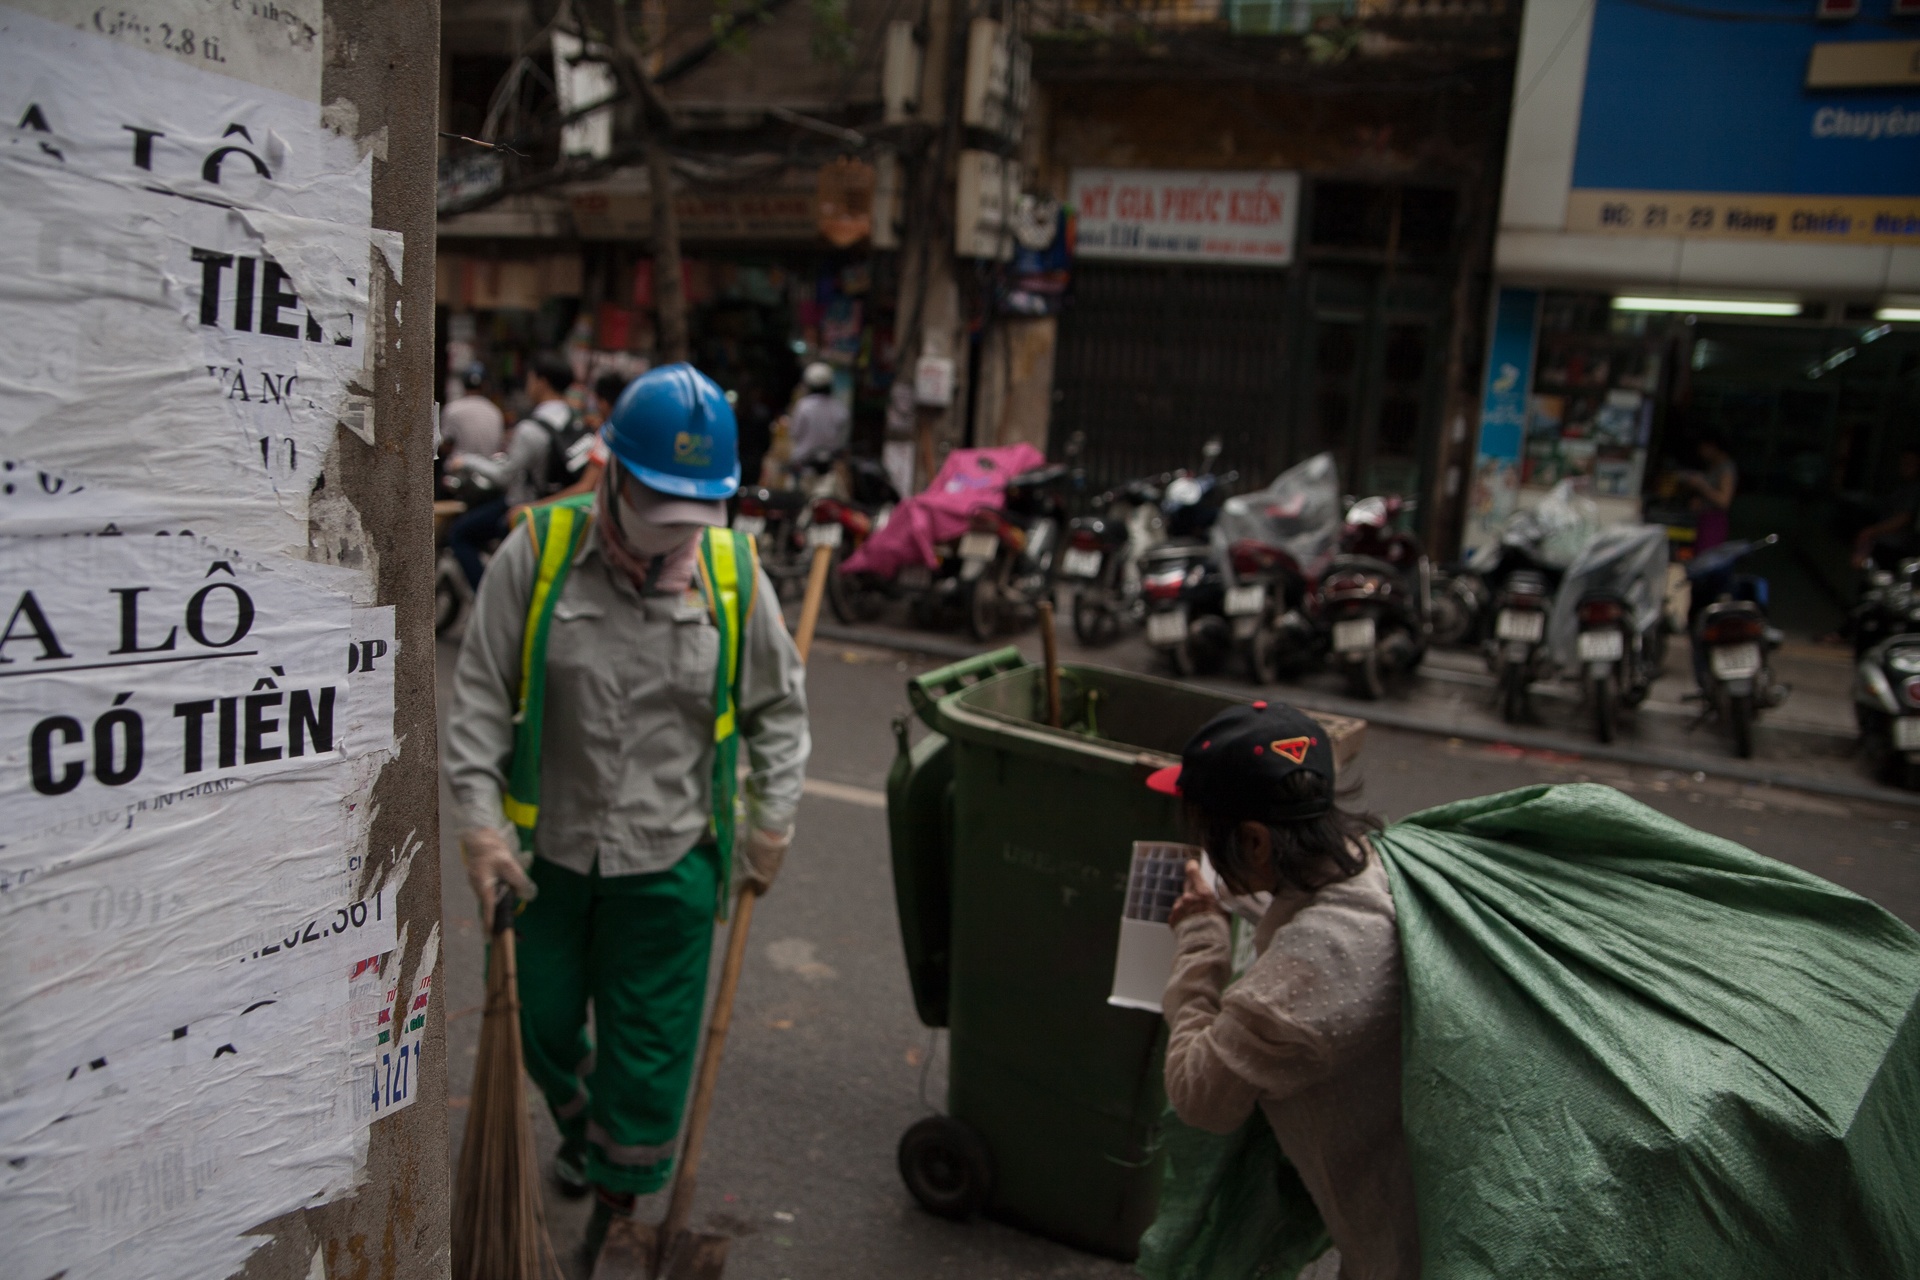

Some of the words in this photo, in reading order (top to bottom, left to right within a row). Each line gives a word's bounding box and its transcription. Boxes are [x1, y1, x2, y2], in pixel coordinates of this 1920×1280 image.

[108, 561, 255, 655] LÔ
[30, 692, 144, 796] CÓ
[174, 665, 336, 774] TIỀN
